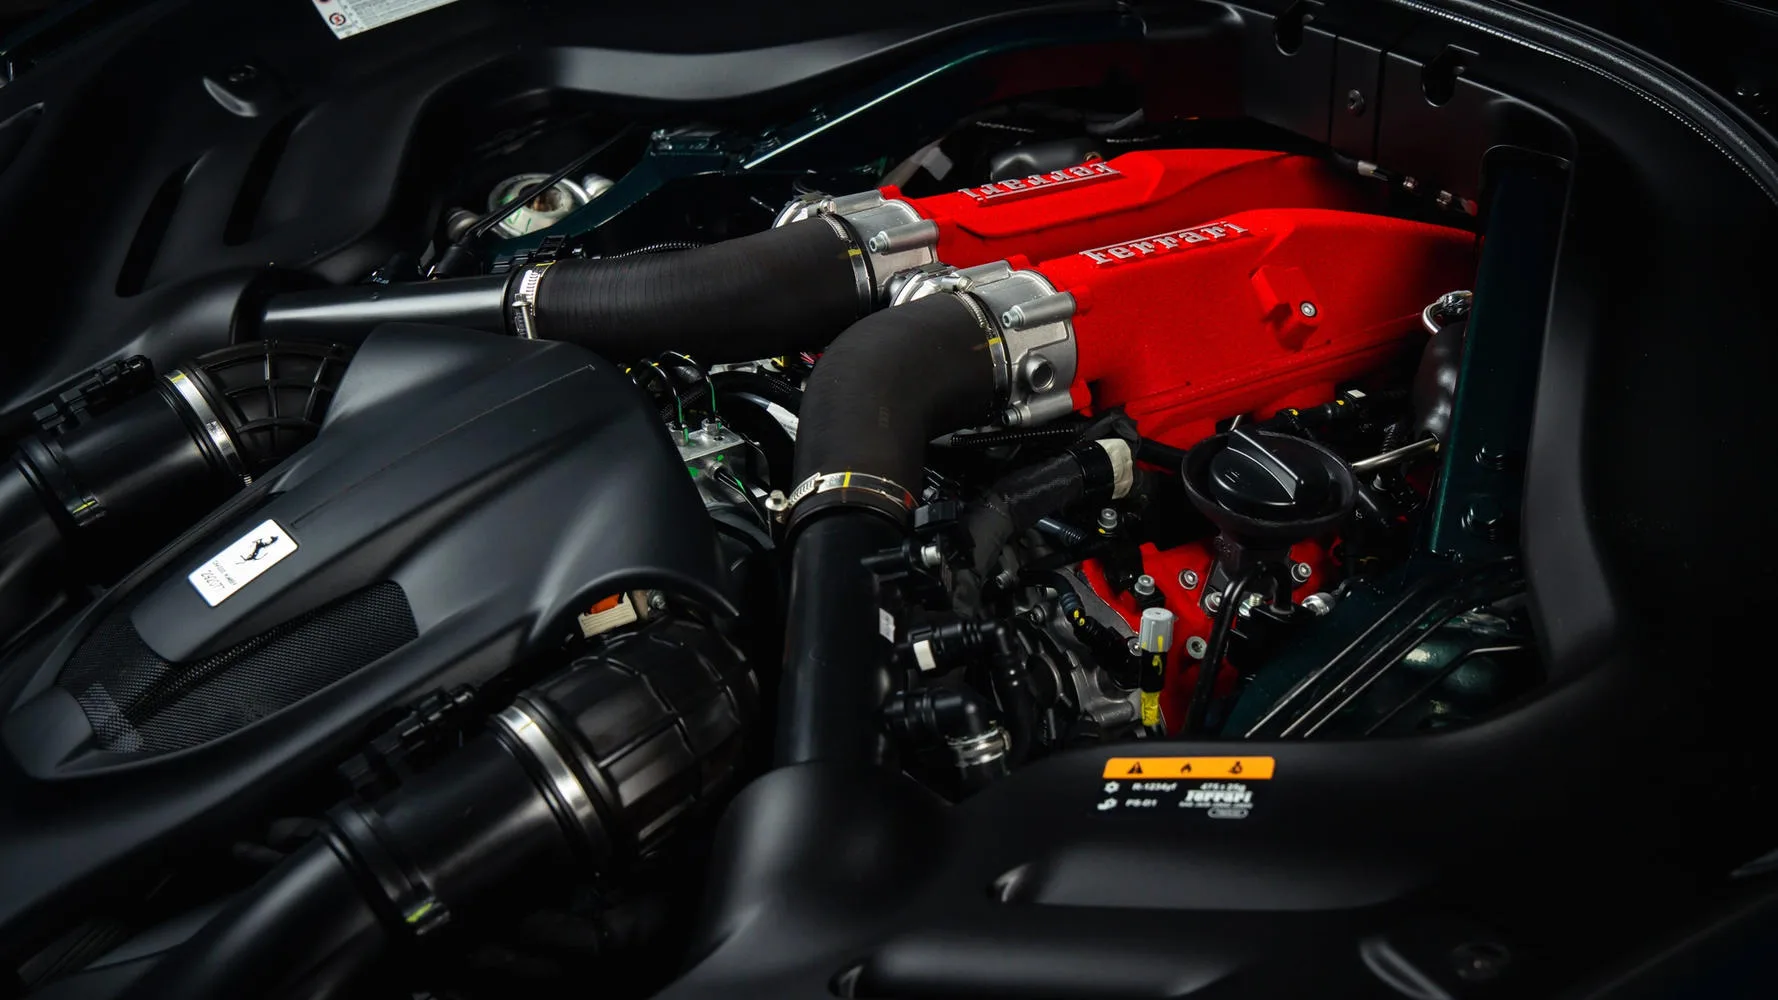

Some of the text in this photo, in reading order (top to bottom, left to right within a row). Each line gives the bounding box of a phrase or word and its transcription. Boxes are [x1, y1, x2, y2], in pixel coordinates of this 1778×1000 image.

[957, 162, 1120, 202] Ferrari
[1079, 220, 1248, 264] Ferrari
[1185, 790, 1253, 803] Ferrari
